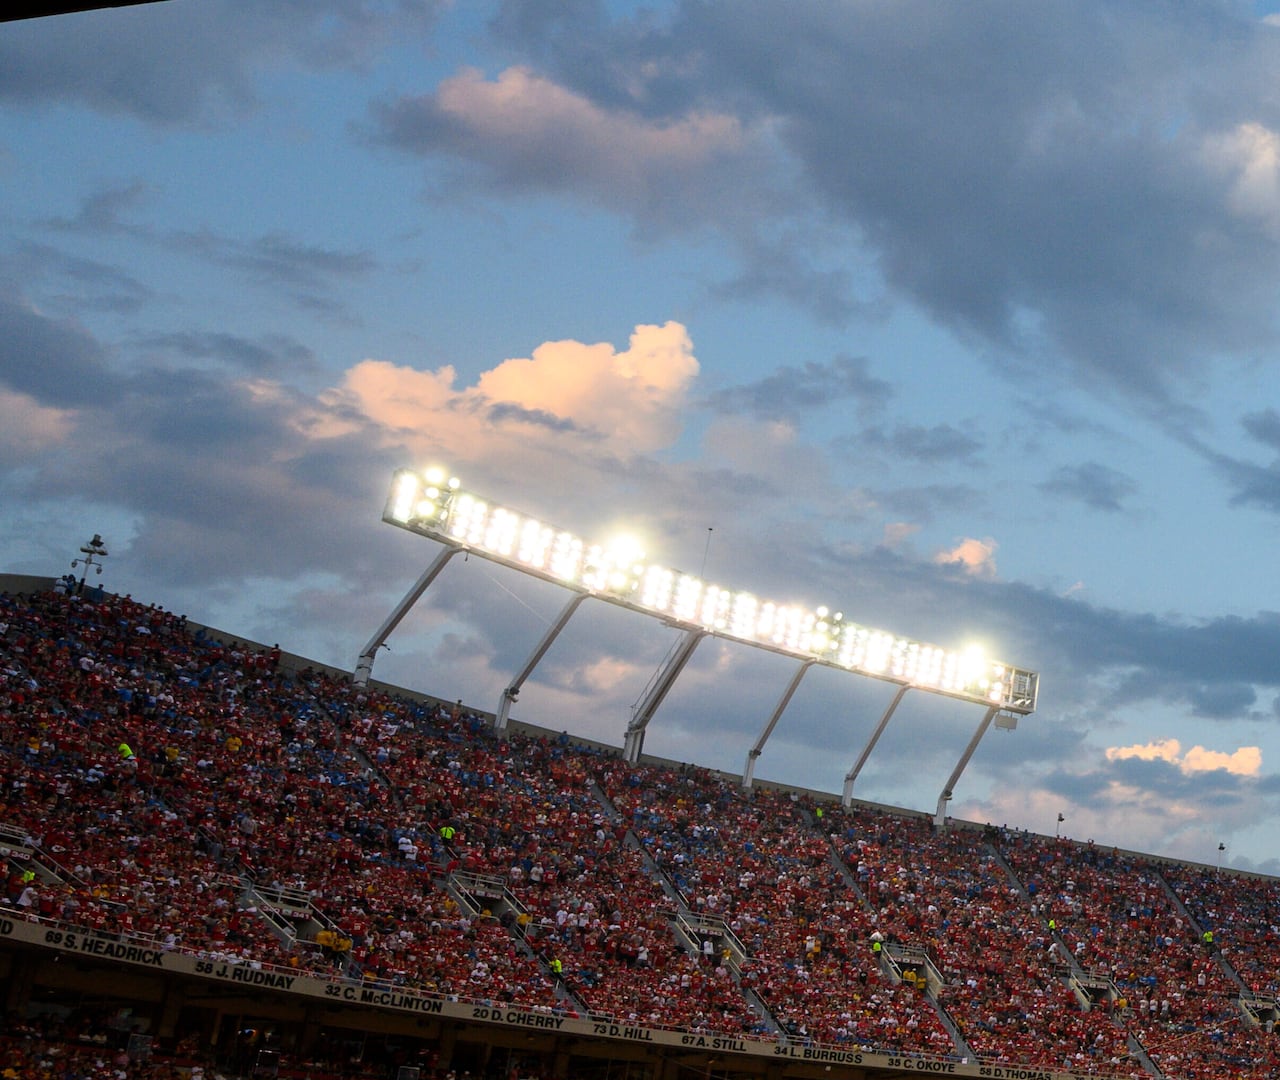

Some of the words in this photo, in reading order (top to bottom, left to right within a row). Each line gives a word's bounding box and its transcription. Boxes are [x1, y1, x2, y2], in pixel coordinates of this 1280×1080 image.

[46, 931, 62, 946] 69
[64, 935, 77, 950] S.
[82, 939, 164, 966] HEADRICK
[195, 961, 212, 975] 58
[217, 965, 228, 979] J.
[232, 966, 296, 990] RUDNAY
[325, 985, 341, 997] 32
[344, 988, 357, 1001] C.
[361, 990, 442, 1014] McCLINTON
[473, 1008, 489, 1019] 20
[491, 1009, 504, 1022] D.
[507, 1012, 564, 1029] CHERRY
[593, 1024, 603, 1034] 73
[605, 1025, 621, 1039] D.
[624, 1027, 653, 1041] HILL
[682, 1035, 694, 1045] 67
[695, 1036, 711, 1048] A.
[713, 1038, 747, 1051] STILL
[774, 1046, 788, 1056] 34
[790, 1047, 801, 1058] L.
[803, 1048, 863, 1064] BURRUSS
[888, 1057, 901, 1067] 35
[904, 1058, 916, 1070] C.
[917, 1059, 956, 1073] OKOYE
